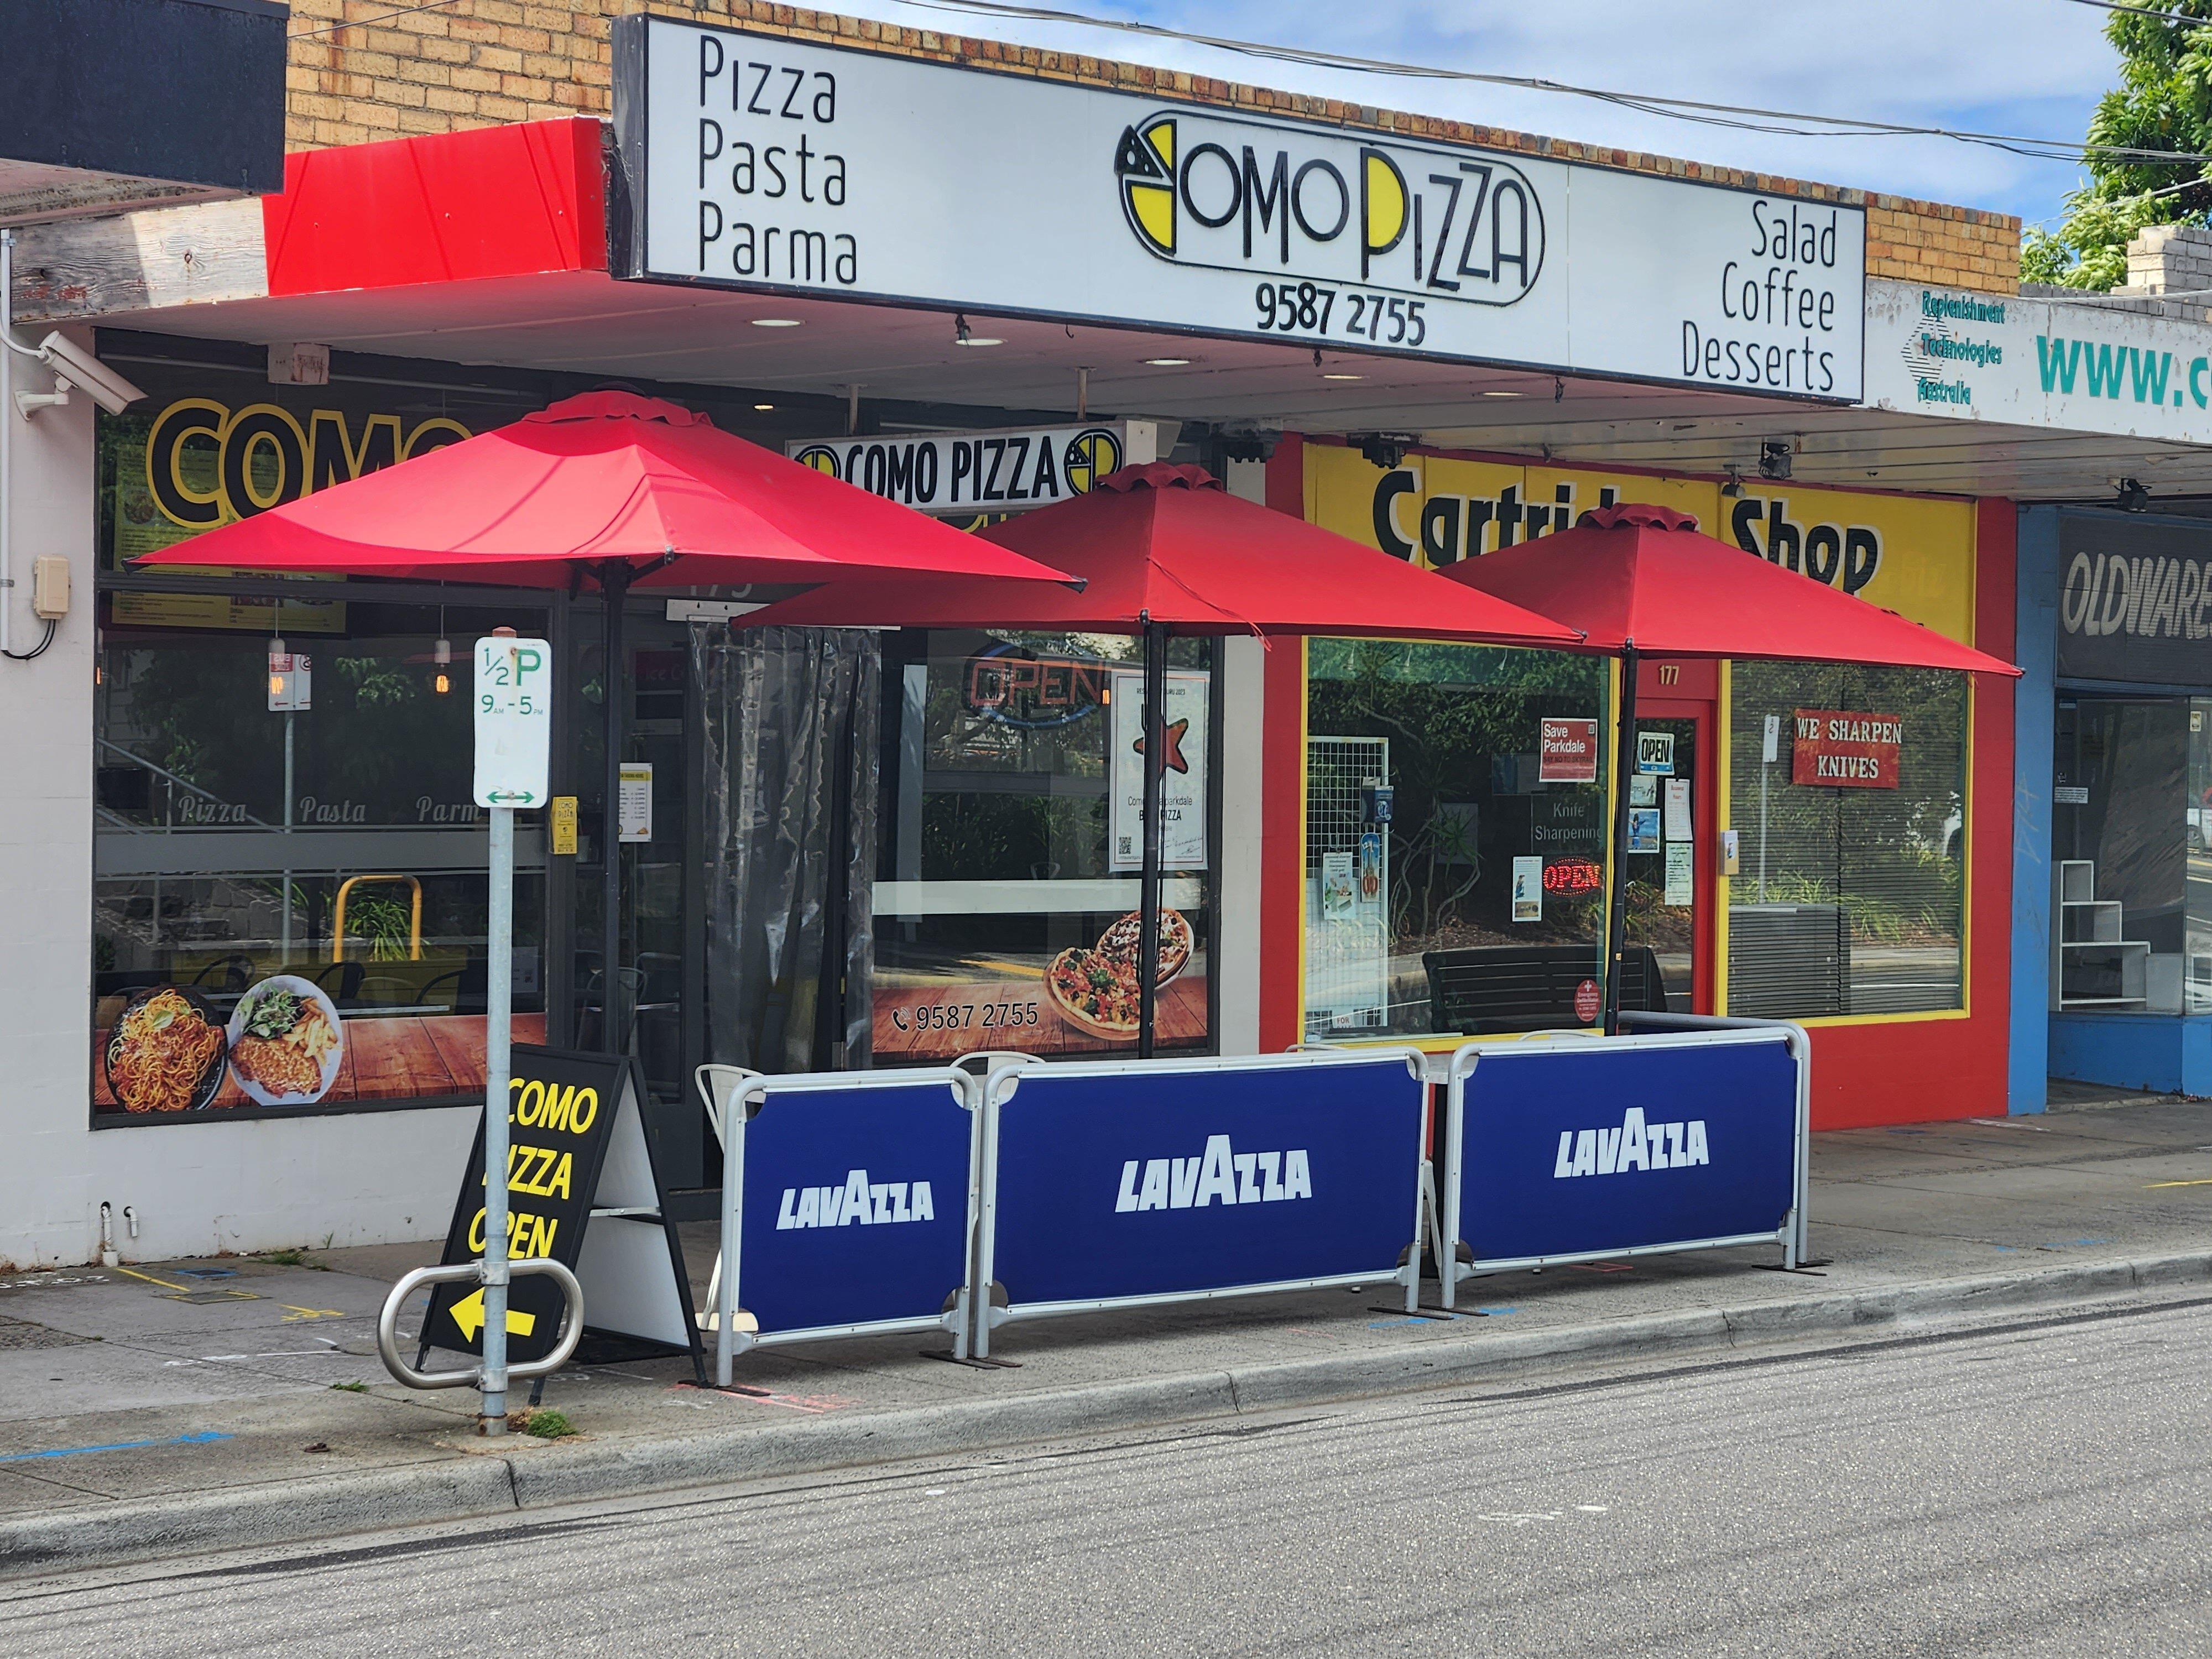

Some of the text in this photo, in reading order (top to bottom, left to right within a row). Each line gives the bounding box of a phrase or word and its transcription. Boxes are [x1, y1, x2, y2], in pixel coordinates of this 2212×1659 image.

[700, 34, 836, 123] Pizza
[699, 118, 846, 205] Pasta
[699, 200, 857, 284] Parma
[1751, 200, 1837, 268] Salad
[1255, 282, 1426, 346] 9587 2755
[1722, 261, 1834, 331] Coffee
[1922, 290, 2005, 324] Replenishment
[1682, 320, 1834, 392] Desserts
[1921, 332, 2002, 368] Technologies
[1918, 377, 1971, 405] Australia
[2036, 335, 2212, 410] www.c
[845, 435, 1058, 504] COMO PIZZA
[2062, 552, 2212, 639] OLDWARE
[970, 660, 1103, 706] OPEN
[1658, 665, 1679, 686] 177
[1543, 723, 1568, 738] Save
[1543, 739, 1586, 753] Parkdale
[1641, 738, 1670, 763] OPEN
[1797, 718, 1902, 744] WE SHARPEN
[1817, 755, 1879, 779] KNIVES
[178, 795, 247, 822] Pizza
[300, 796, 366, 822] Pasta
[1128, 796, 1144, 806] Com
[1553, 802, 1585, 817] Knife
[1535, 825, 1603, 843] Sharpening
[1543, 864, 1600, 888] OPEN
[916, 1001, 1039, 1031] 9587 2755
[1554, 1107, 1710, 1178] LAVAZZA
[482, 1144, 572, 1199] IZZA
[1114, 1134, 1312, 1213] LAVAZZA
[775, 1169, 935, 1230] LAVAZZA
